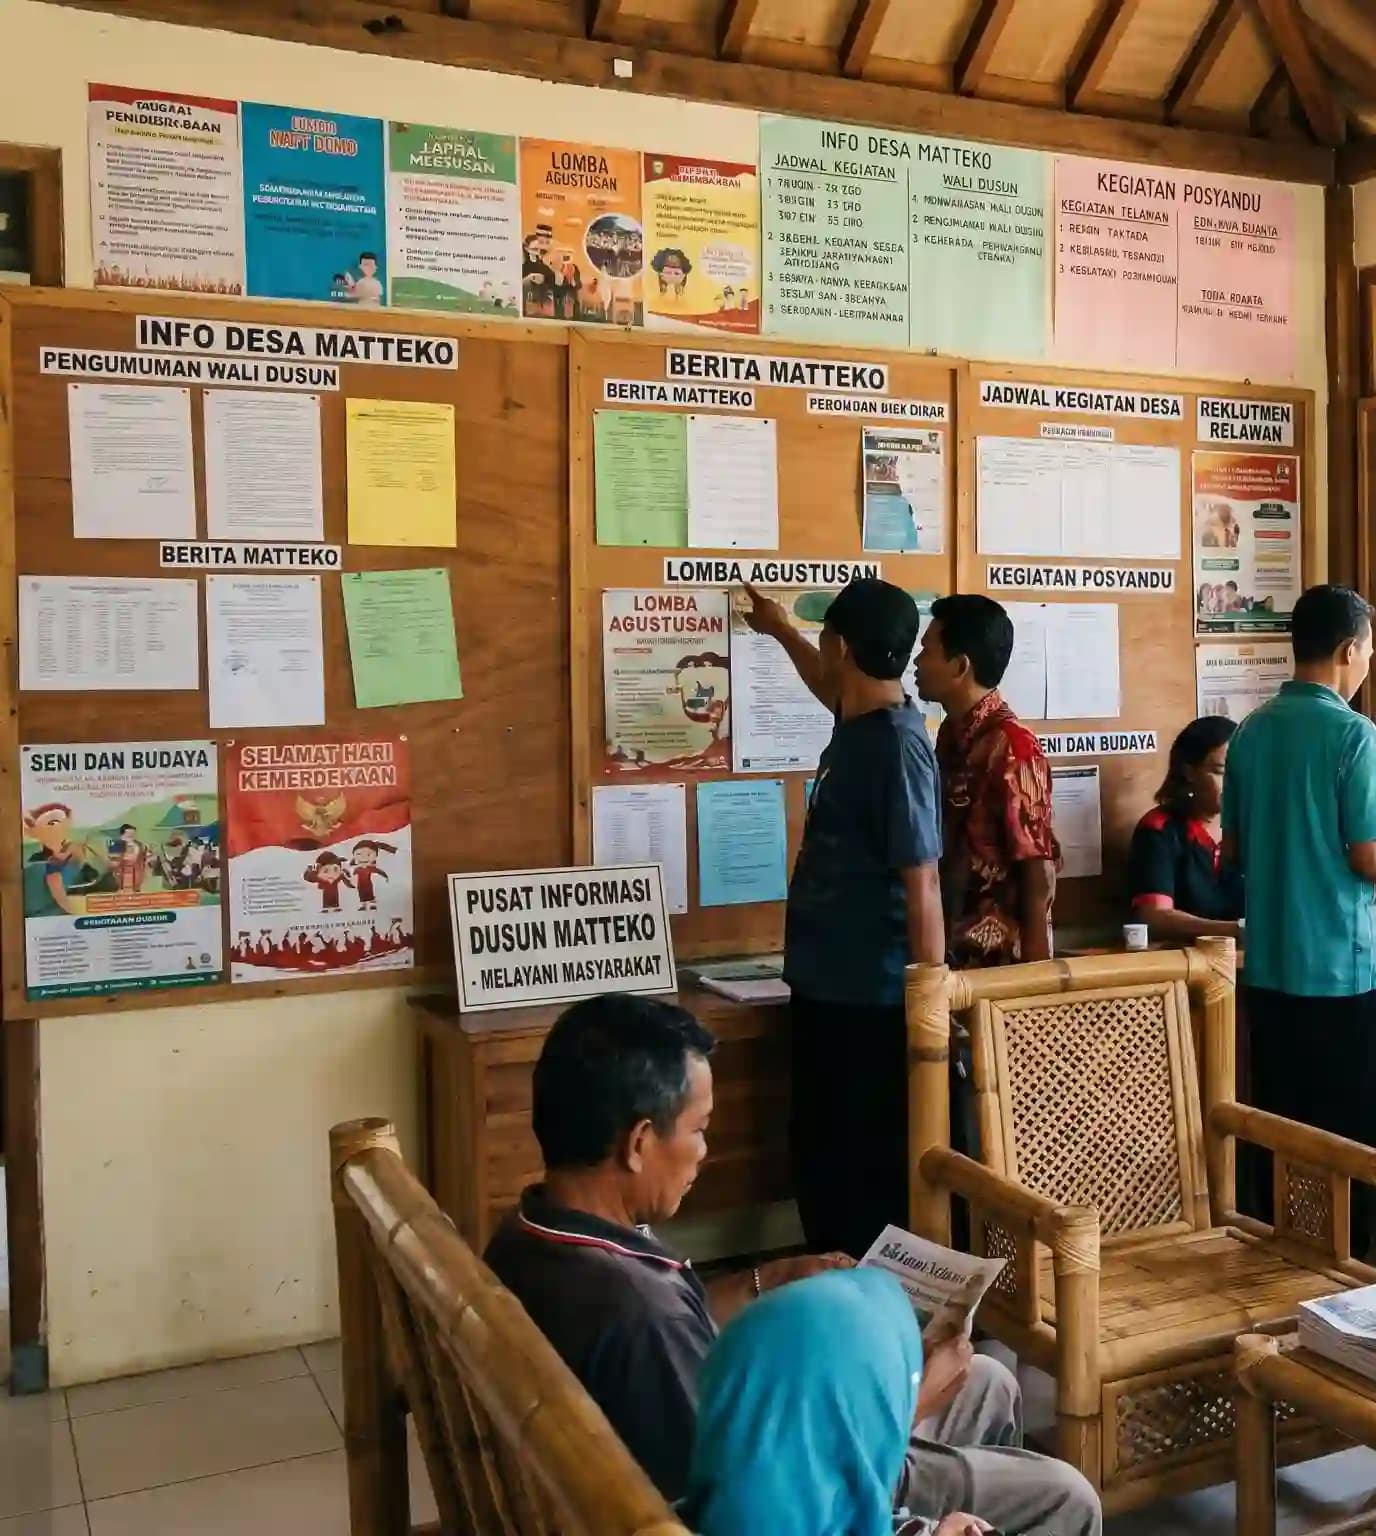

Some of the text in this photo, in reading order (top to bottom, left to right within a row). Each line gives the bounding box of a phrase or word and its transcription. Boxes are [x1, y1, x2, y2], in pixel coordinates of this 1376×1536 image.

[821, 131, 992, 170] INFO DESA MATTEKO
[552, 152, 608, 175] LOMBA
[774, 154, 896, 179] JADWAL KEGIATAN
[943, 174, 1018, 194] WALI DUSUN
[1097, 173, 1261, 212] KEGIATAN POSYANDU
[1061, 199, 1115, 216] KEGIATAN
[139, 320, 454, 365] INFO DESA MATTEKO
[44, 352, 337, 386] PENGUMUMAN WALI DUSUN
[670, 353, 885, 390] BERITA MATTEKO
[606, 382, 752, 407] BERITA MATTEKO
[982, 386, 1181, 417] JADWAL KEGIATAN DESA
[1200, 401, 1291, 423] REKLUTMEN
[1210, 422, 1282, 442] RELAWAN
[161, 546, 339, 567] BERITA MATTEKO
[666, 561, 878, 584] LOMBA AGUSTUSAN
[989, 567, 1172, 589] KEGIATAN POSYANDU
[633, 595, 698, 613] LOMBA
[609, 616, 723, 634] AGUSTUSAN
[240, 742, 394, 767] SELAMAT HARI
[1038, 734, 1156, 753] ENI DAN BUDAYA
[30, 750, 209, 771] SENI DAN BUDAYA
[239, 766, 398, 792] KEMERDEKAAN
[467, 878, 652, 914] PUSAT INFORMASI
[469, 913, 656, 955] DUSUN MATTEKO
[480, 963, 559, 990] MELAYANI
[562, 955, 662, 983] MASYARAKAT
